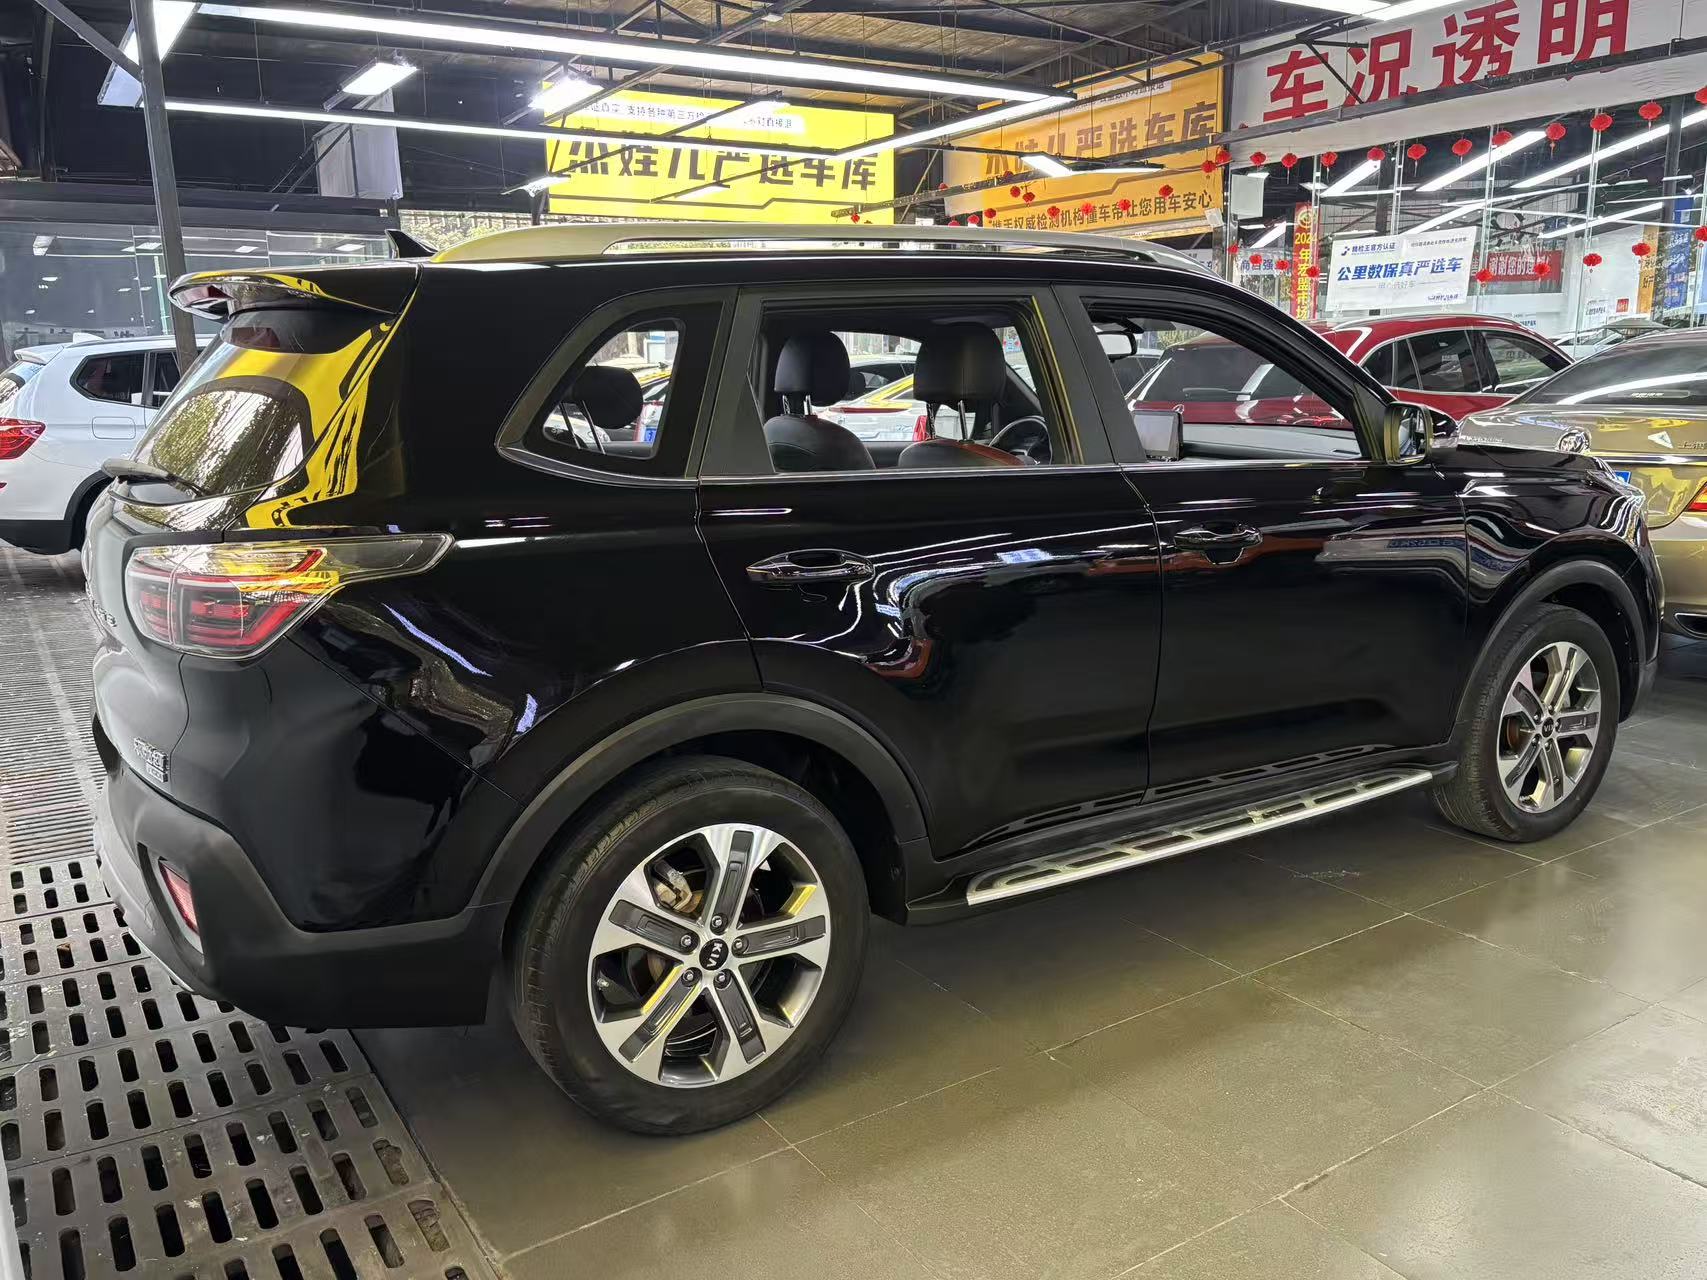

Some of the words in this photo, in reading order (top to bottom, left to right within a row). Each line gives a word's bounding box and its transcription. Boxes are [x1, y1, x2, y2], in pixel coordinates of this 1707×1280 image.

[1263, 0, 1632, 122] 车况透明
[1337, 256, 1464, 282] 公里数保真严选车
[706, 942, 723, 968] KIA
